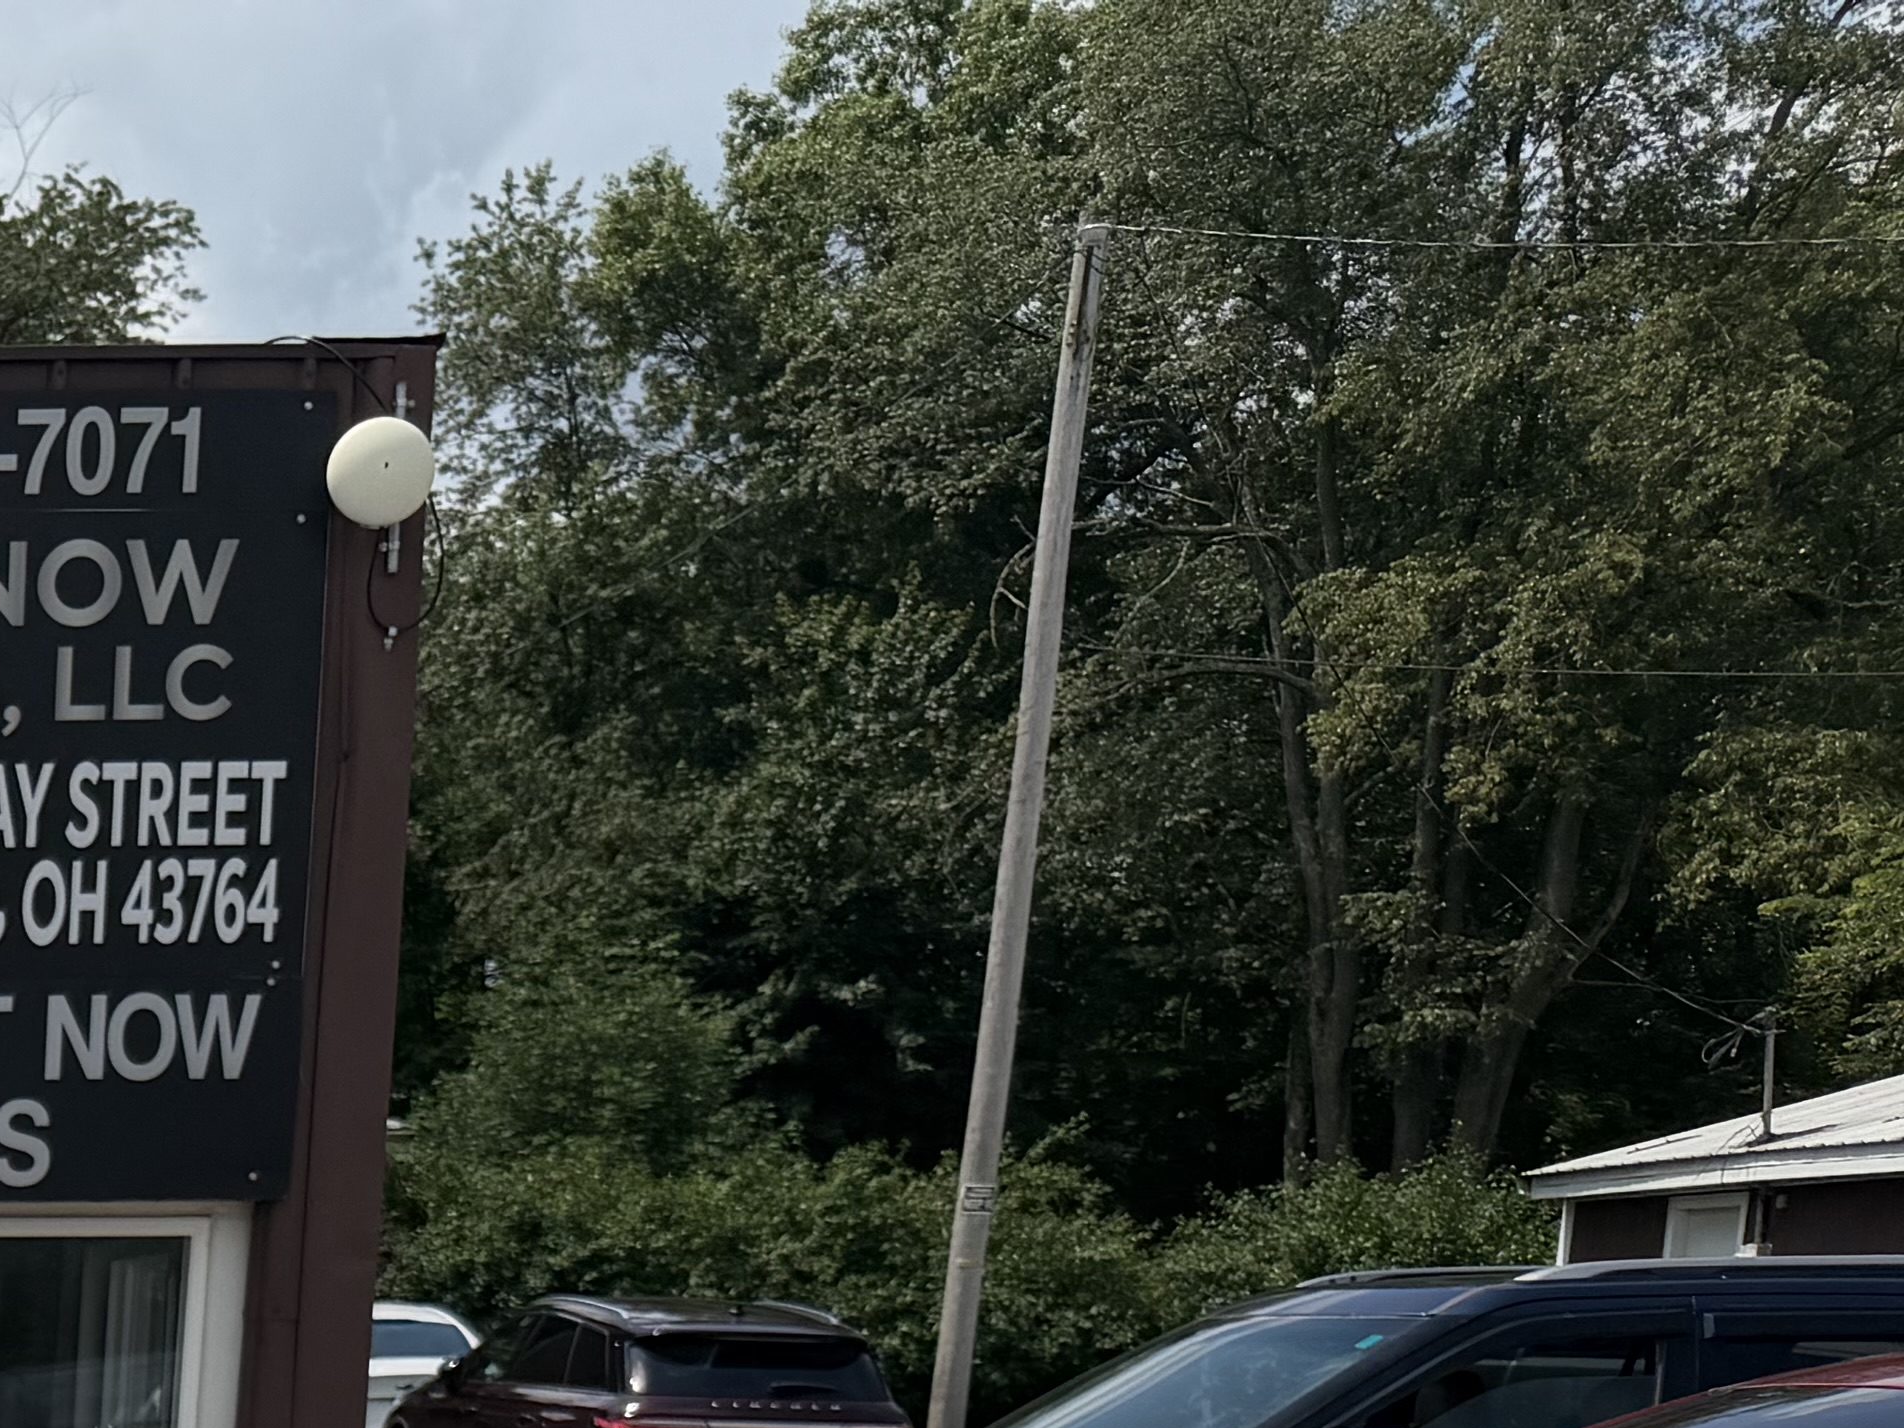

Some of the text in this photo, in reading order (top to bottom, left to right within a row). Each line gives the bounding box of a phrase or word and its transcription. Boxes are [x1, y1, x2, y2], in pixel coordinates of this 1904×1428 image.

[55, 644, 233, 720] LLC
[65, 761, 287, 848] STREET
[22, 860, 107, 946] OH
[121, 858, 279, 944] 43764
[45, 992, 261, 1081] NOW
